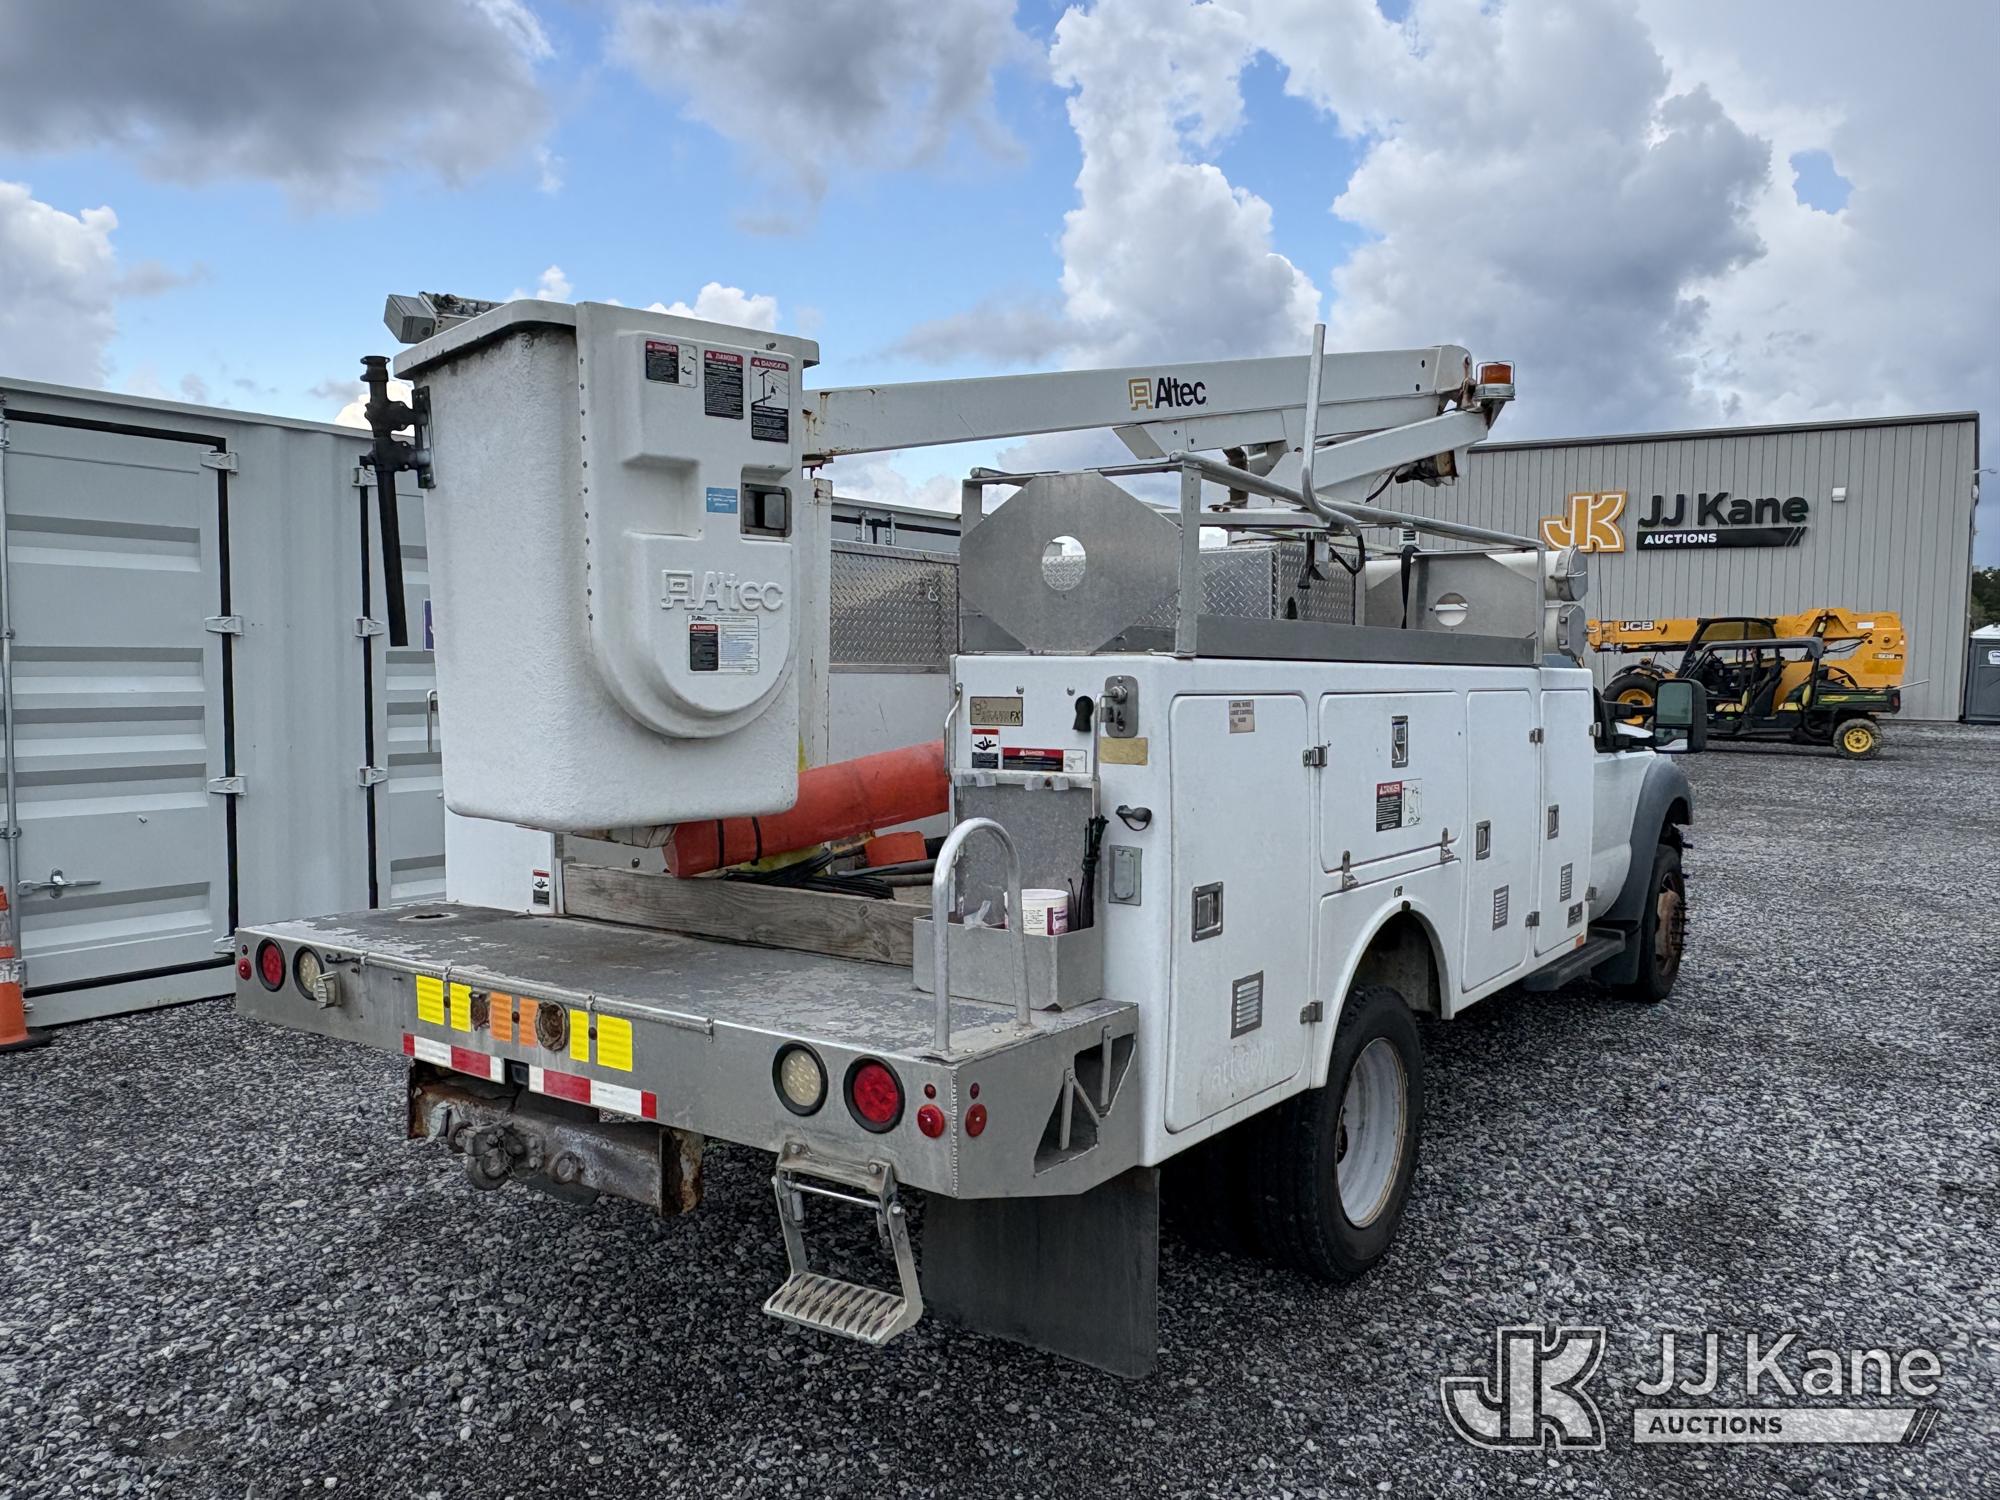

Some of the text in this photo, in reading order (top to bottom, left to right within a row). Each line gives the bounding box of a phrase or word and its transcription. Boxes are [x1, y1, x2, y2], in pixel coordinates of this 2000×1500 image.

[761, 361, 787, 369] DANGER
[1155, 377, 1207, 408] Altec
[1540, 491, 1626, 552] JK
[1639, 492, 1809, 527] JJ Kane
[1644, 533, 1717, 545] AUCTIONS
[697, 571, 783, 611] Altec
[1620, 621, 1653, 631] JCB
